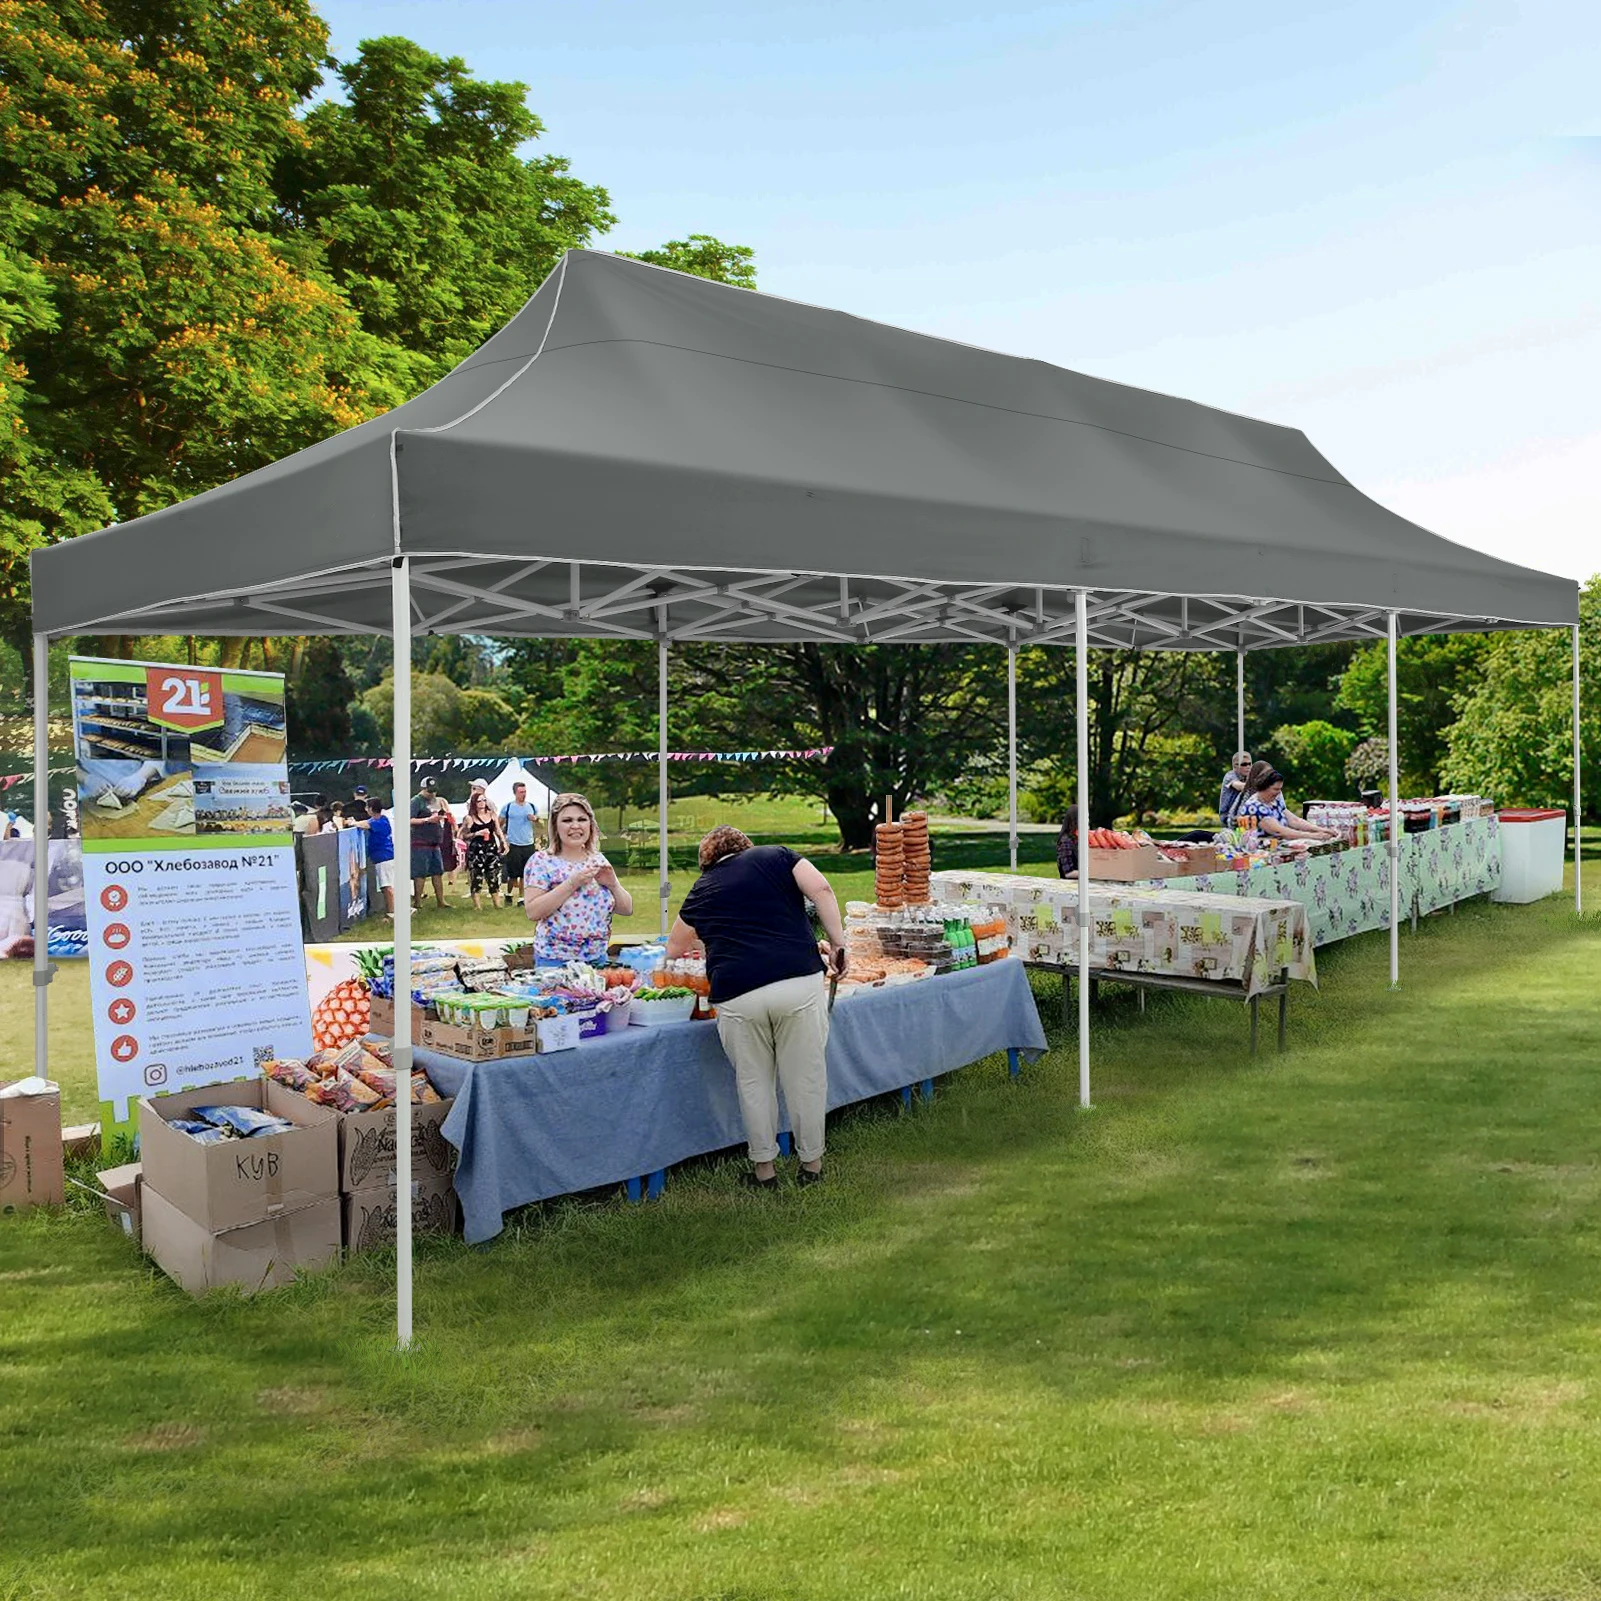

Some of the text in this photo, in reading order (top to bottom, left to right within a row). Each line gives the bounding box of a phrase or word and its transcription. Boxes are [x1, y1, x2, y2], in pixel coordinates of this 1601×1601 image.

[105, 855, 279, 874] ООО "Хлебозавод №21"
